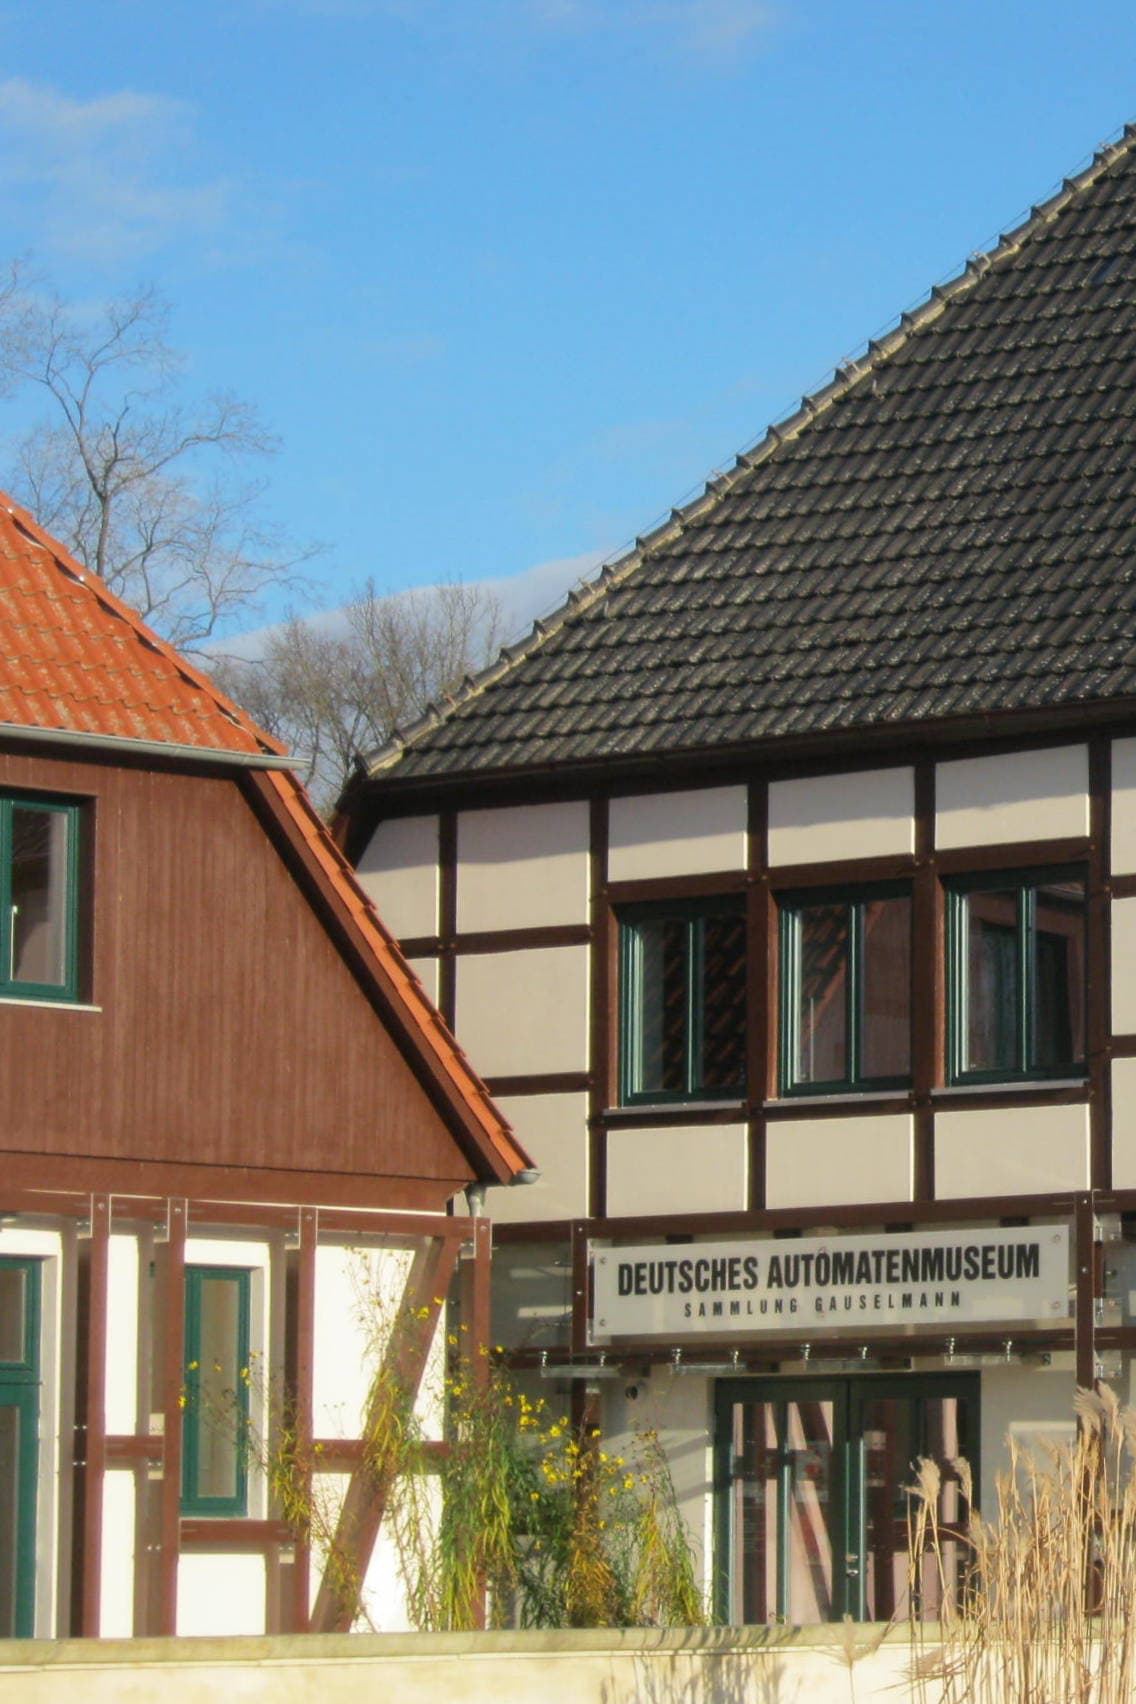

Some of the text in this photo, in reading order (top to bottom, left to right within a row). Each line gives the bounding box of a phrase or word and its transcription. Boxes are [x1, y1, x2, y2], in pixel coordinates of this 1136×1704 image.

[617, 1243, 1040, 1296] DEUTSCHES AUTOMATENMUSEUM
[684, 1290, 961, 1318] SAMMLUNG GAUSELMANN
